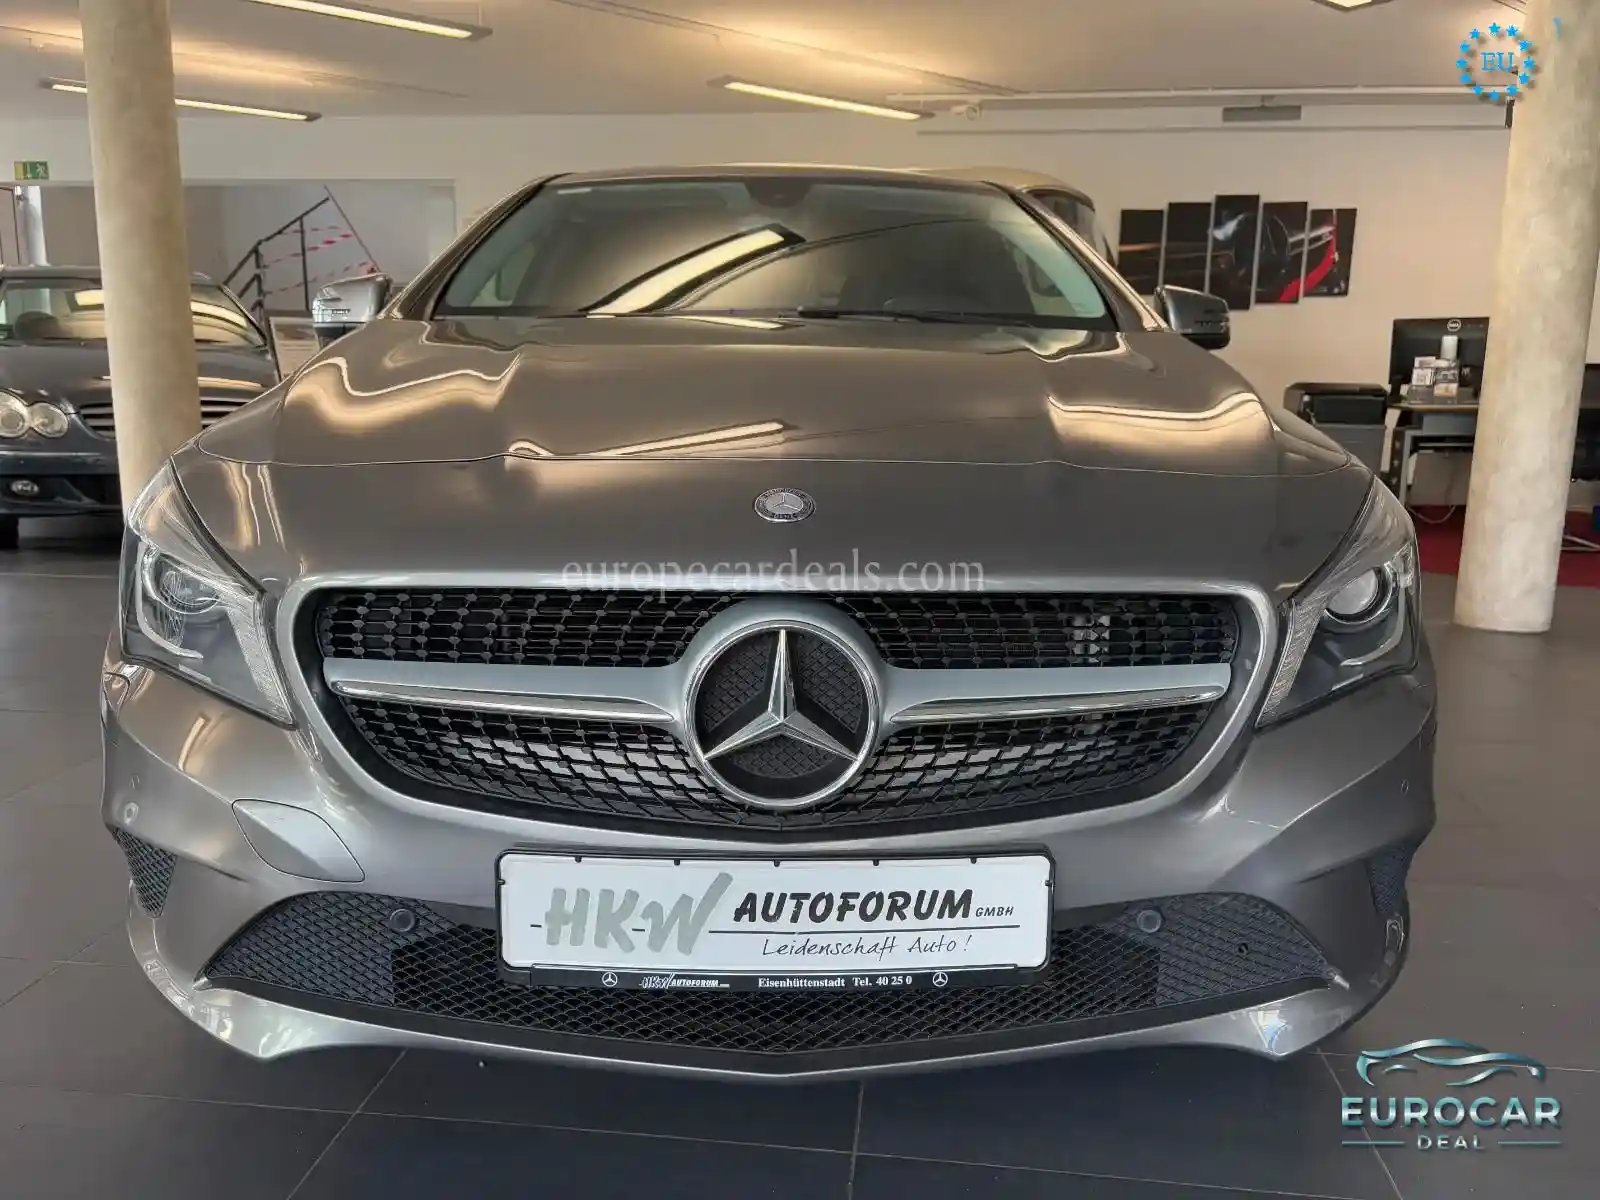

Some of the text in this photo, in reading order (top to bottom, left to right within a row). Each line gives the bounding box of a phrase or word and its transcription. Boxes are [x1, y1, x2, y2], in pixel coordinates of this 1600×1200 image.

[733, 888, 973, 923] AUTOFORUM
[975, 906, 1014, 917] GMBH
[762, 936, 896, 961] Leidenschaft
[758, 977, 845, 988] Eisenhüttenstadt
[852, 977, 873, 987] Tel.
